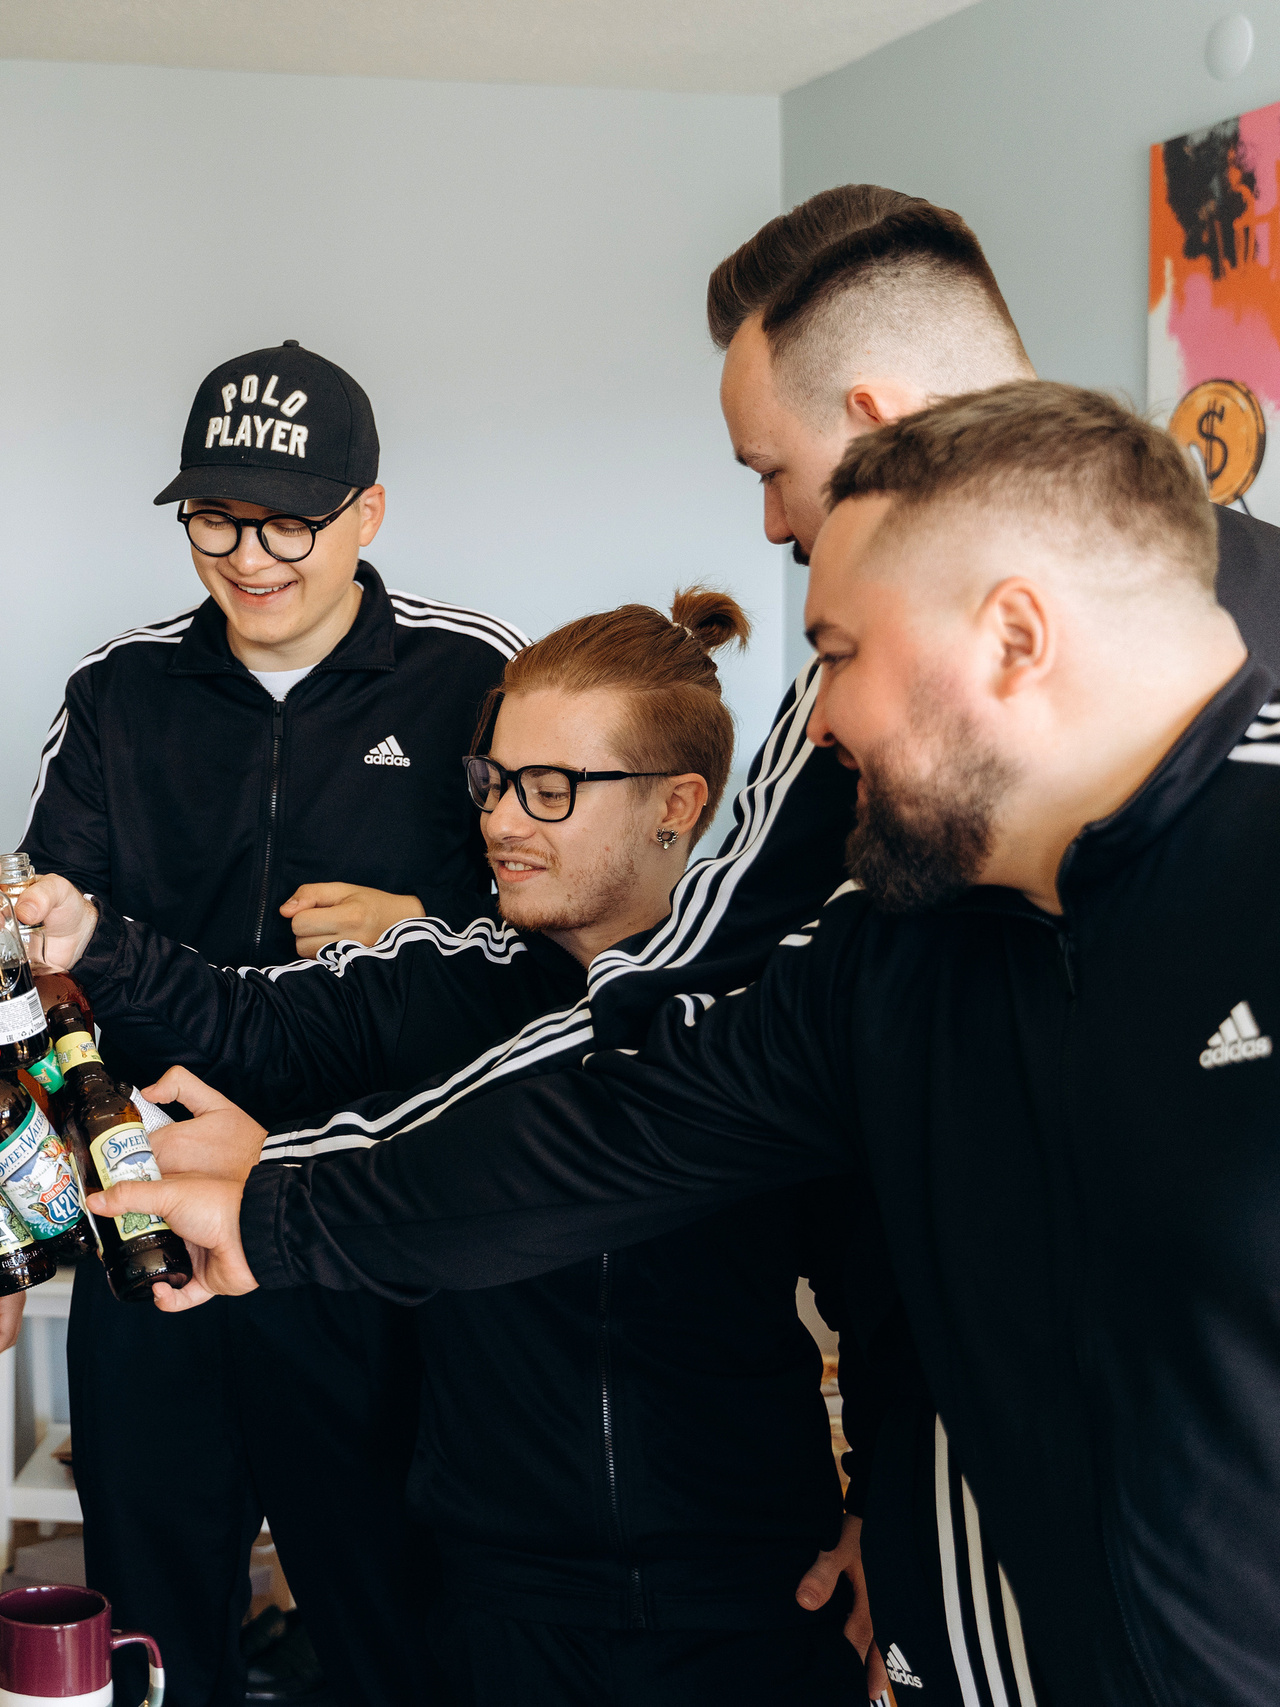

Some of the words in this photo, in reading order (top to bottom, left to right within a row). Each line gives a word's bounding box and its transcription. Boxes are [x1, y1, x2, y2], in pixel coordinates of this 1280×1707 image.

[221, 374, 308, 418] POLO
[204, 414, 309, 459] PLAYER
[363, 753, 411, 768] adidas
[1199, 1036, 1273, 1070] adidas
[44, 1190, 56, 1202] EXTRA
[55, 1182, 64, 1194] PALE
[51, 1185, 80, 1219] 420
